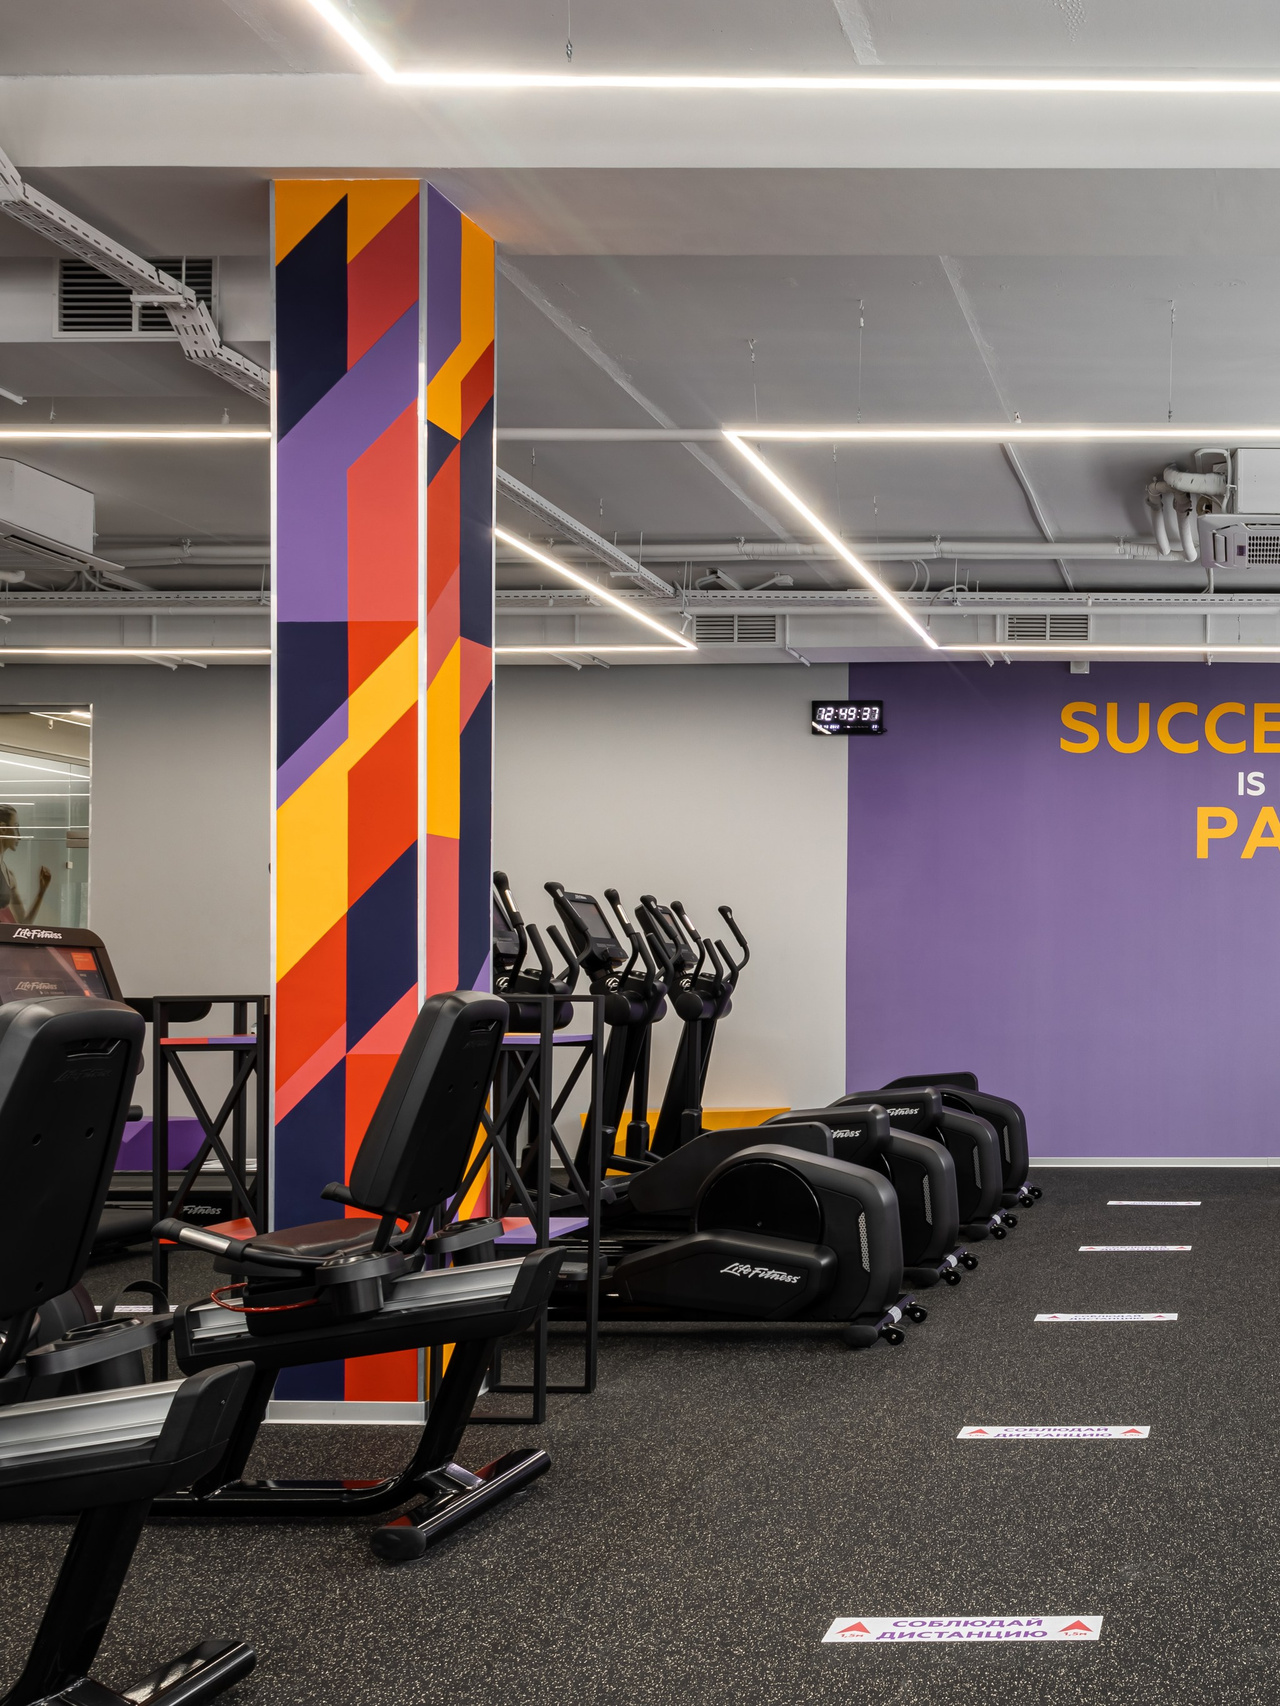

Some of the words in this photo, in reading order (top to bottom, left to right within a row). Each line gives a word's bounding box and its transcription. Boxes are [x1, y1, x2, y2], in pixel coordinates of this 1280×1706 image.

[819, 707, 879, 721] 12:49:37
[1238, 772, 1266, 796] IS
[892, 1617, 1043, 1628] СОБЛЮДАЙ
[875, 1630, 1048, 1640] ДИСТАНЦИЮ
